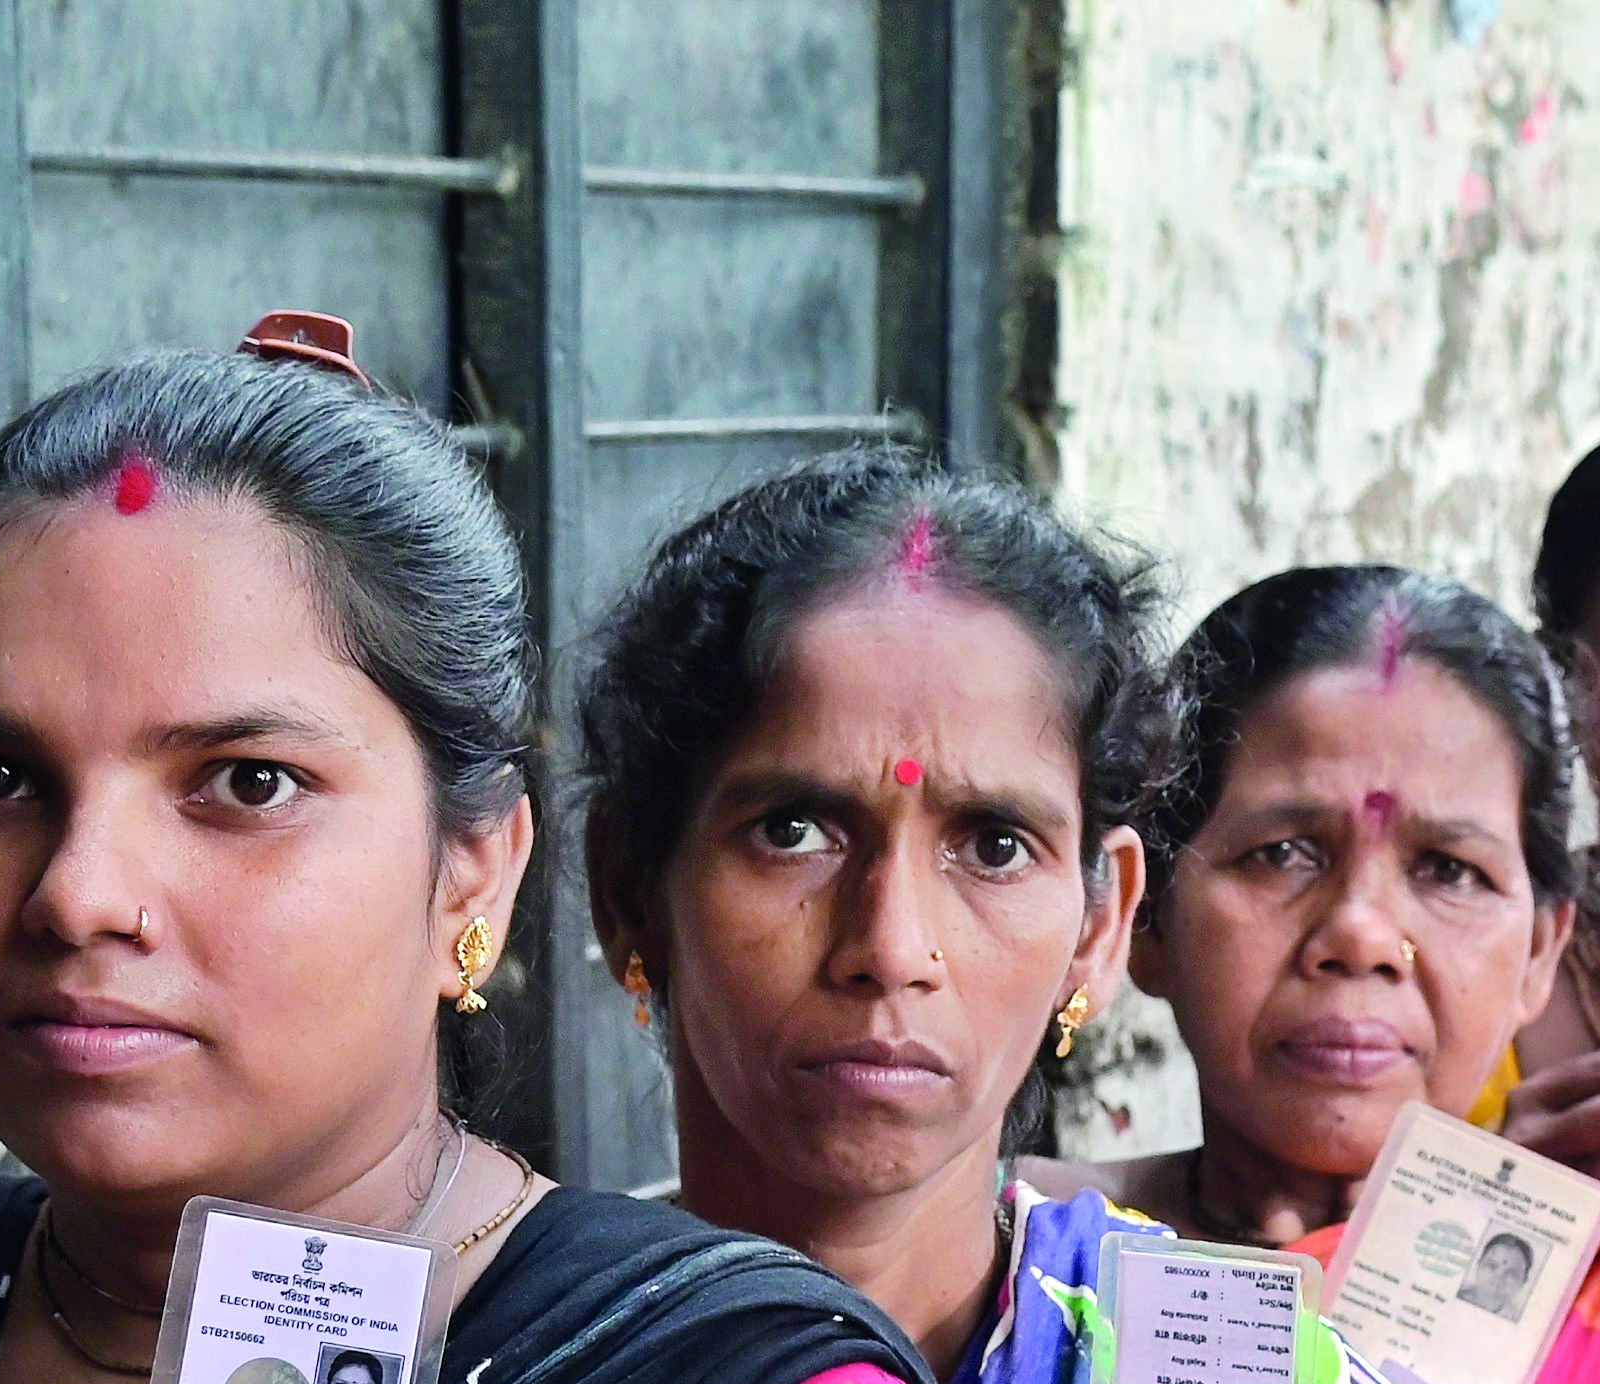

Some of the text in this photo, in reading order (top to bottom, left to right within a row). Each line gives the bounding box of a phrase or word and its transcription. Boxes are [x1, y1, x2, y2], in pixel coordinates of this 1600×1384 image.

[251, 1270, 289, 1285] ভারতের
[1259, 1272, 1269, 1280] of
[1272, 1274, 1294, 1285] Date
[219, 1294, 399, 1333] ELECTION COMMISSION OF INDIA
[263, 1315, 348, 1337] IDENTITY CARD
[201, 1325, 265, 1345] STB2150662
